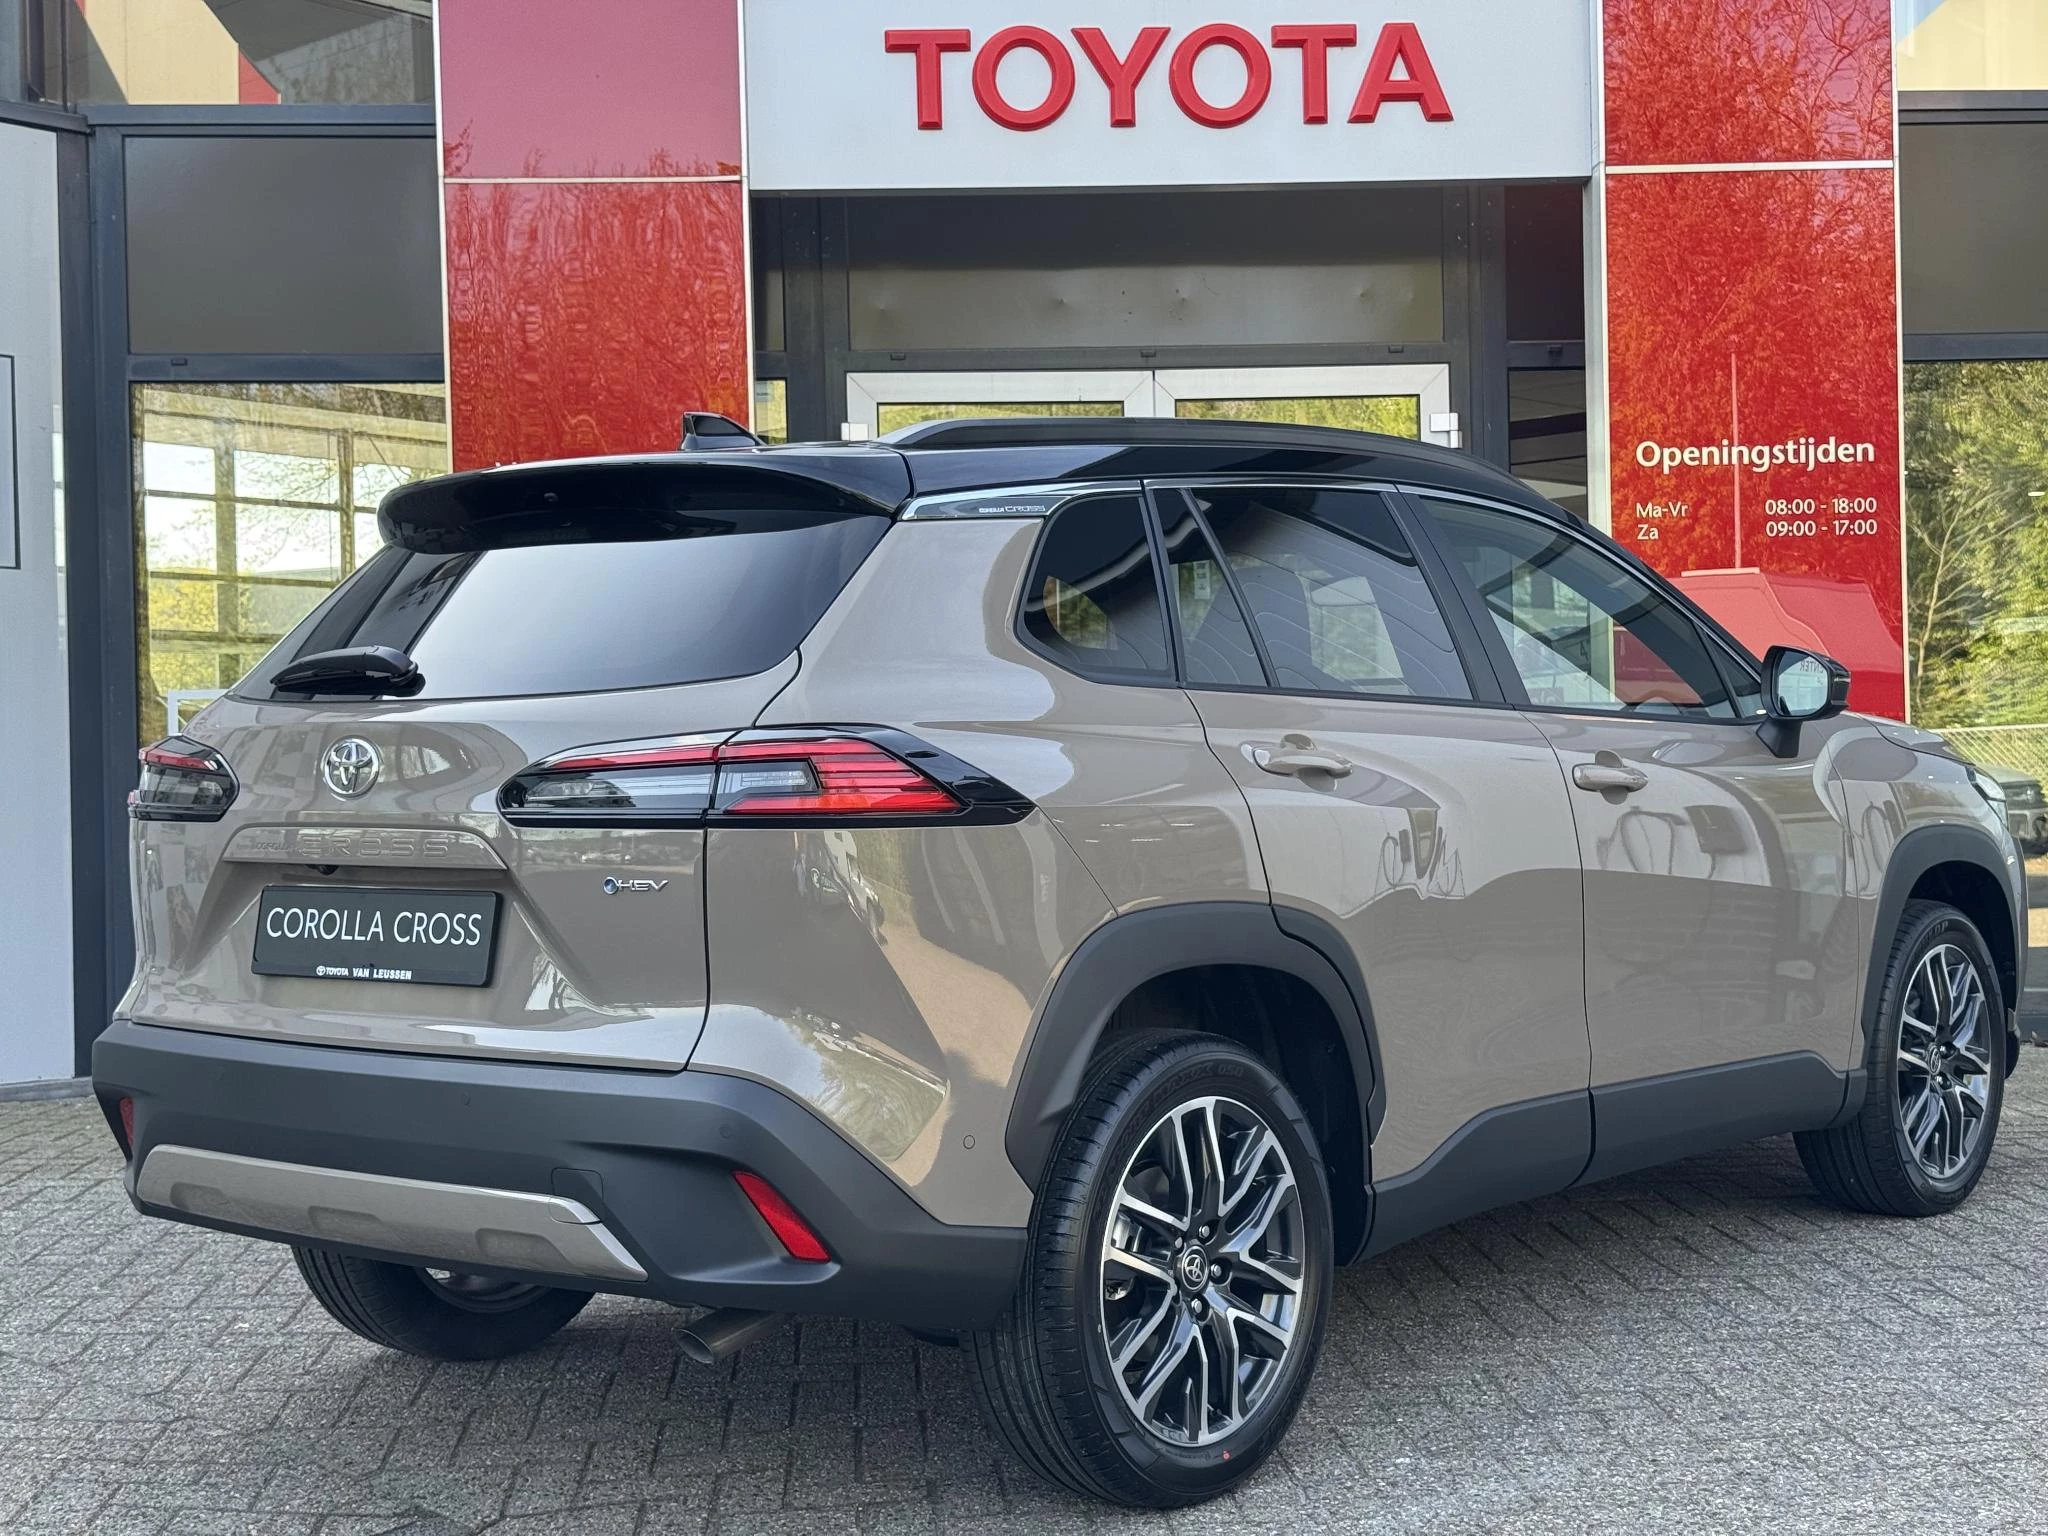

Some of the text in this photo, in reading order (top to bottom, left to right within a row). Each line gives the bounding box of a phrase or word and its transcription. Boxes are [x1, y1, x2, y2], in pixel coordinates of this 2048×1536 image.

[885, 23, 1454, 130] TOYOTA
[1636, 436, 1875, 474] Openingstijden
[1636, 502, 1689, 518] Ma-Vr
[1765, 499, 1816, 515] 08:00
[1832, 497, 1877, 514] 18:00
[1637, 524, 1659, 540] Za
[1765, 521, 1816, 537] 09:00
[1833, 519, 1878, 535] 17:00
[266, 907, 483, 946] COROLLA CROSS
[325, 967, 412, 980] TOYOTA VAN LEUSSEN
